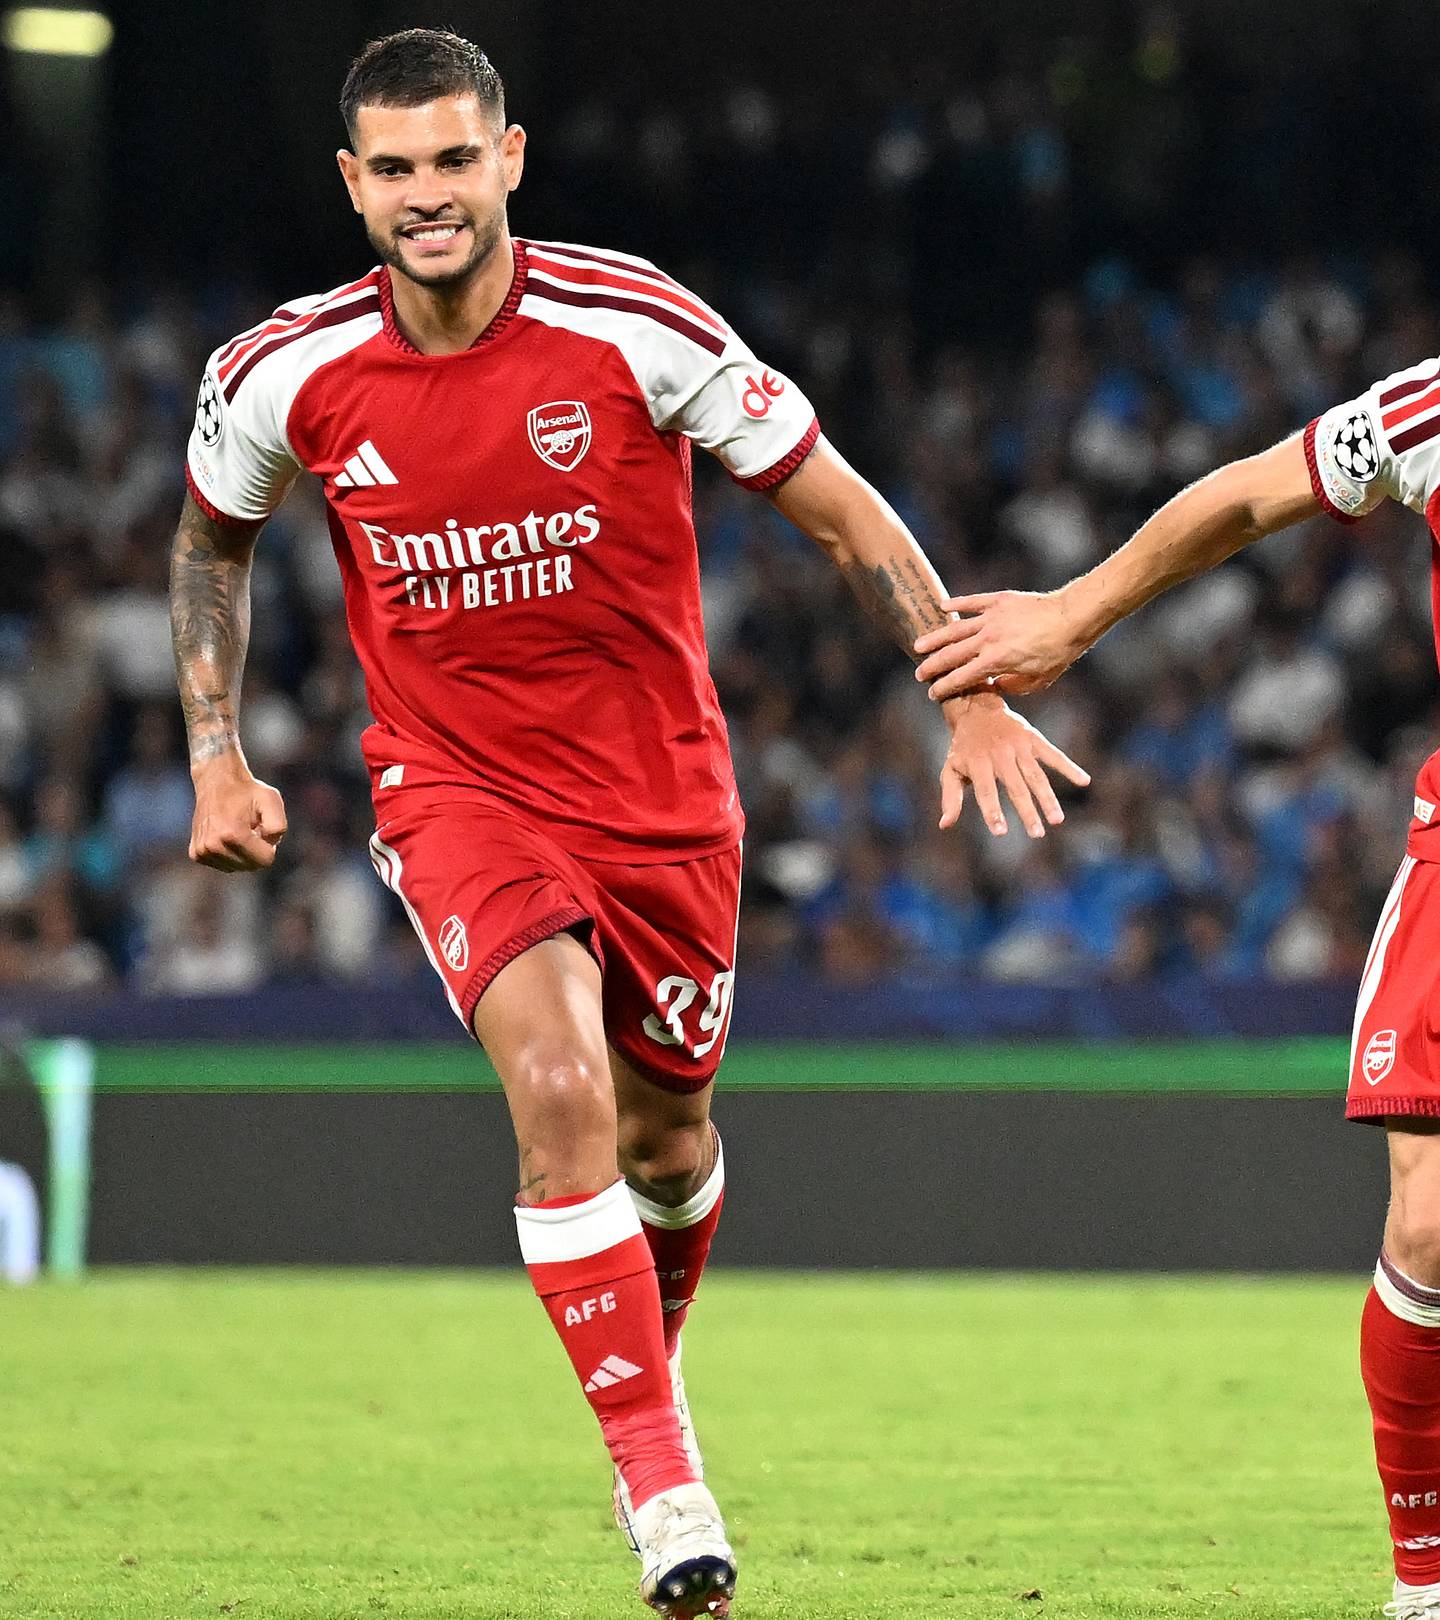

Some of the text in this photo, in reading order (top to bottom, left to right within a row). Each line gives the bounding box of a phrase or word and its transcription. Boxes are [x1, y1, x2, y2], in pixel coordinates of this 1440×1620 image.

[537, 411, 581, 430] Arsenal
[359, 504, 601, 571] Emirates
[405, 554, 575, 610] FLY BETTER
[642, 971, 734, 1059] 39
[564, 1291, 617, 1327] AFC
[1391, 1491, 1437, 1508] AFC
